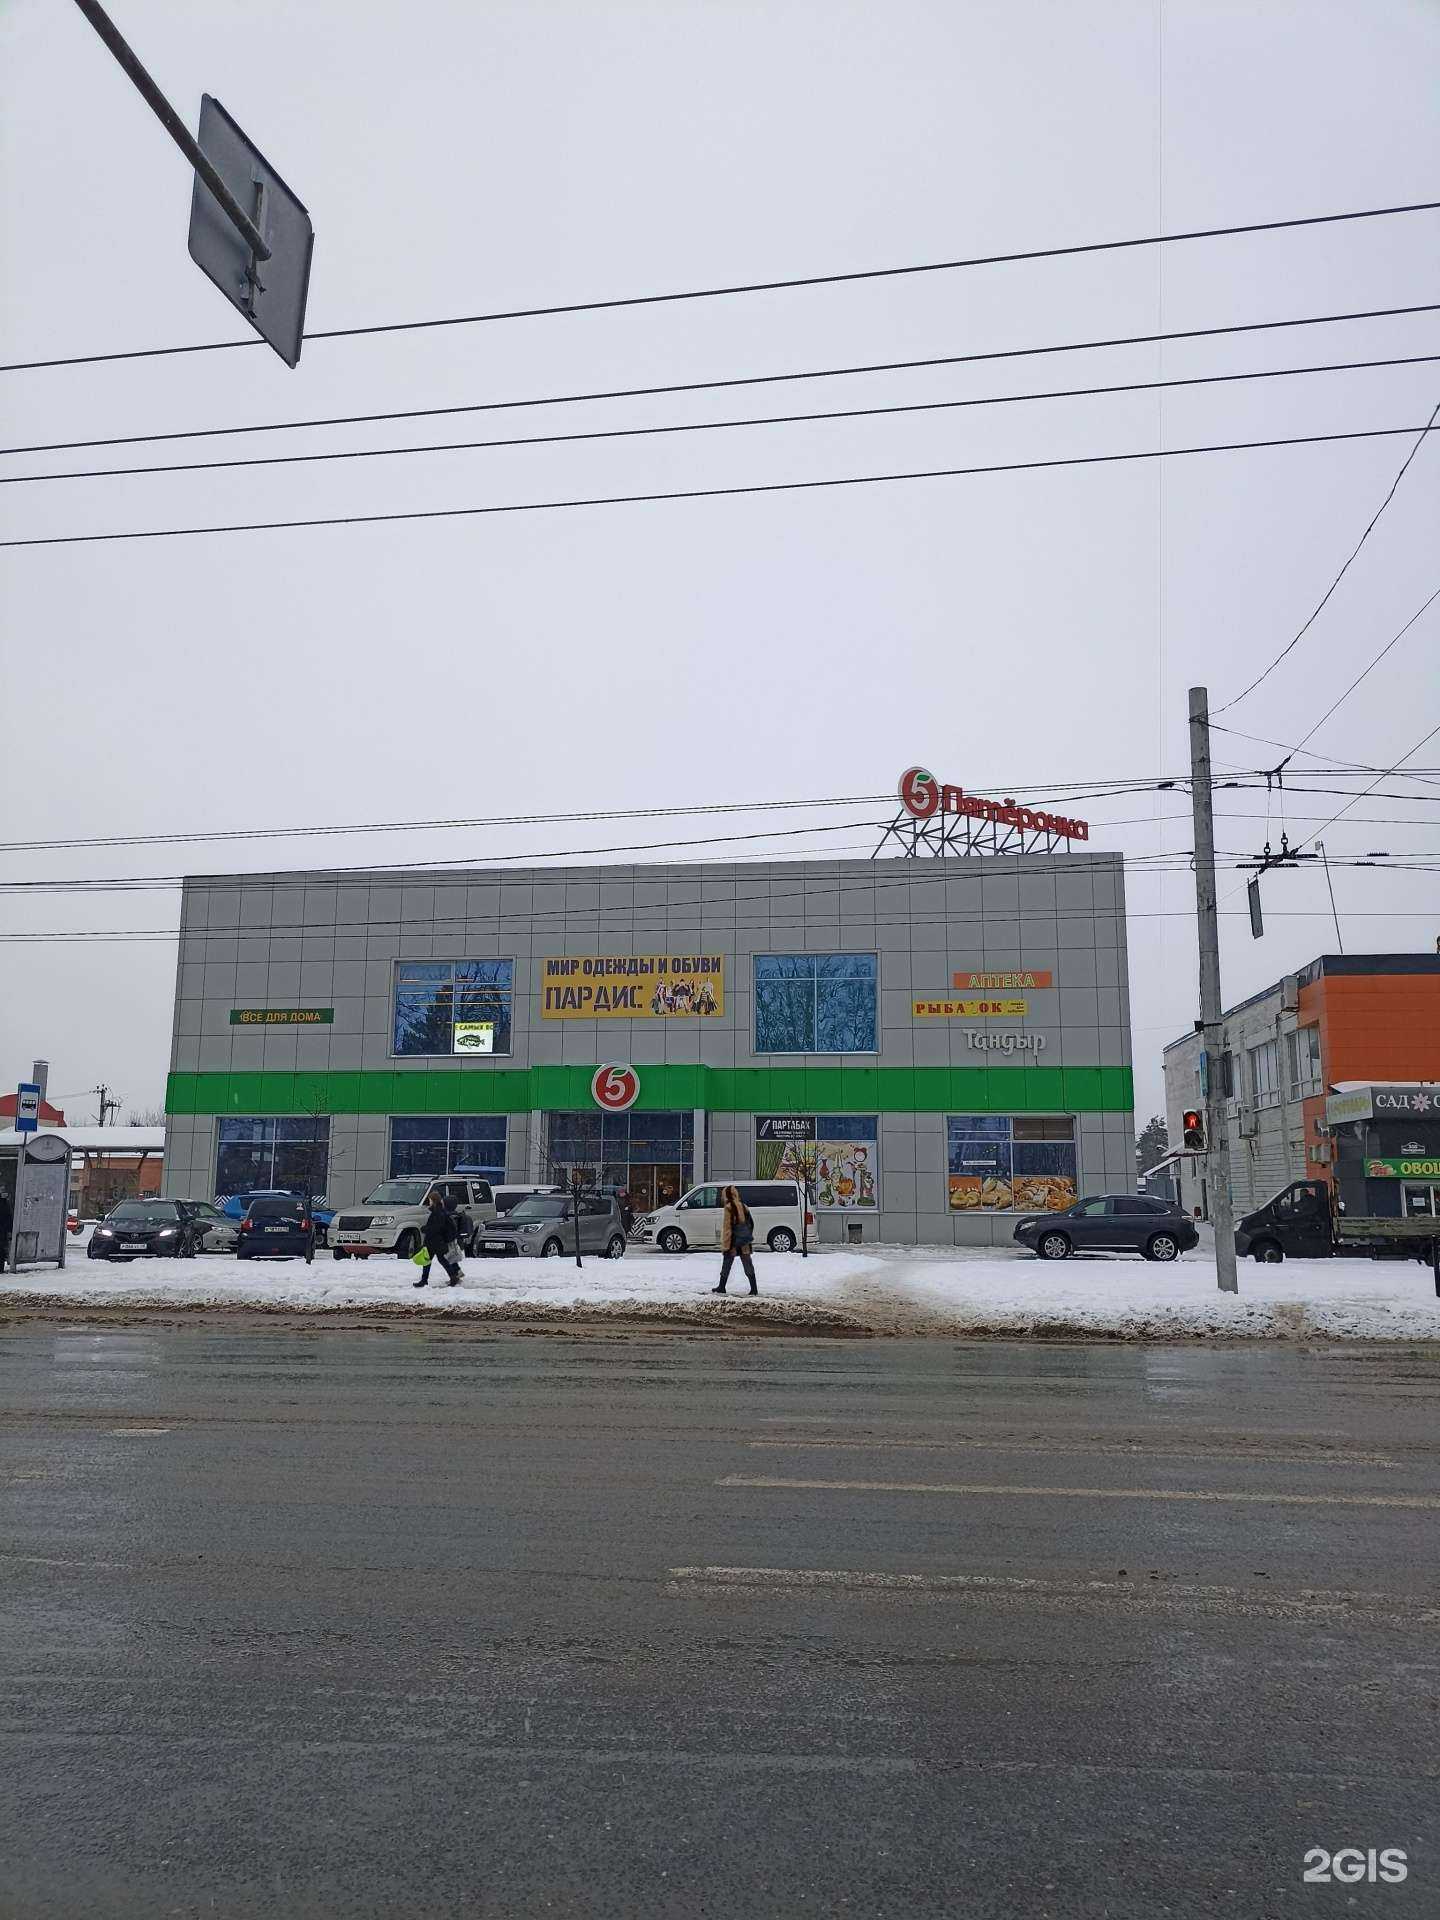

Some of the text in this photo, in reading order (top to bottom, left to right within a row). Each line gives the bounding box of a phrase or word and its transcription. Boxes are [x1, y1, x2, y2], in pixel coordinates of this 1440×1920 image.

[547, 957, 721, 976] МИР ОДЕЖДЫ И ОБУВИ
[968, 973, 1035, 988] АПТЕКА
[546, 985, 643, 1011] ПАРДИС
[242, 1011, 320, 1022] ВСЕ ДЛЯ ДОМА
[963, 1029, 1048, 1057] Тандыр
[604, 1067, 628, 1101] 5
[1375, 1094, 1410, 1110] САД
